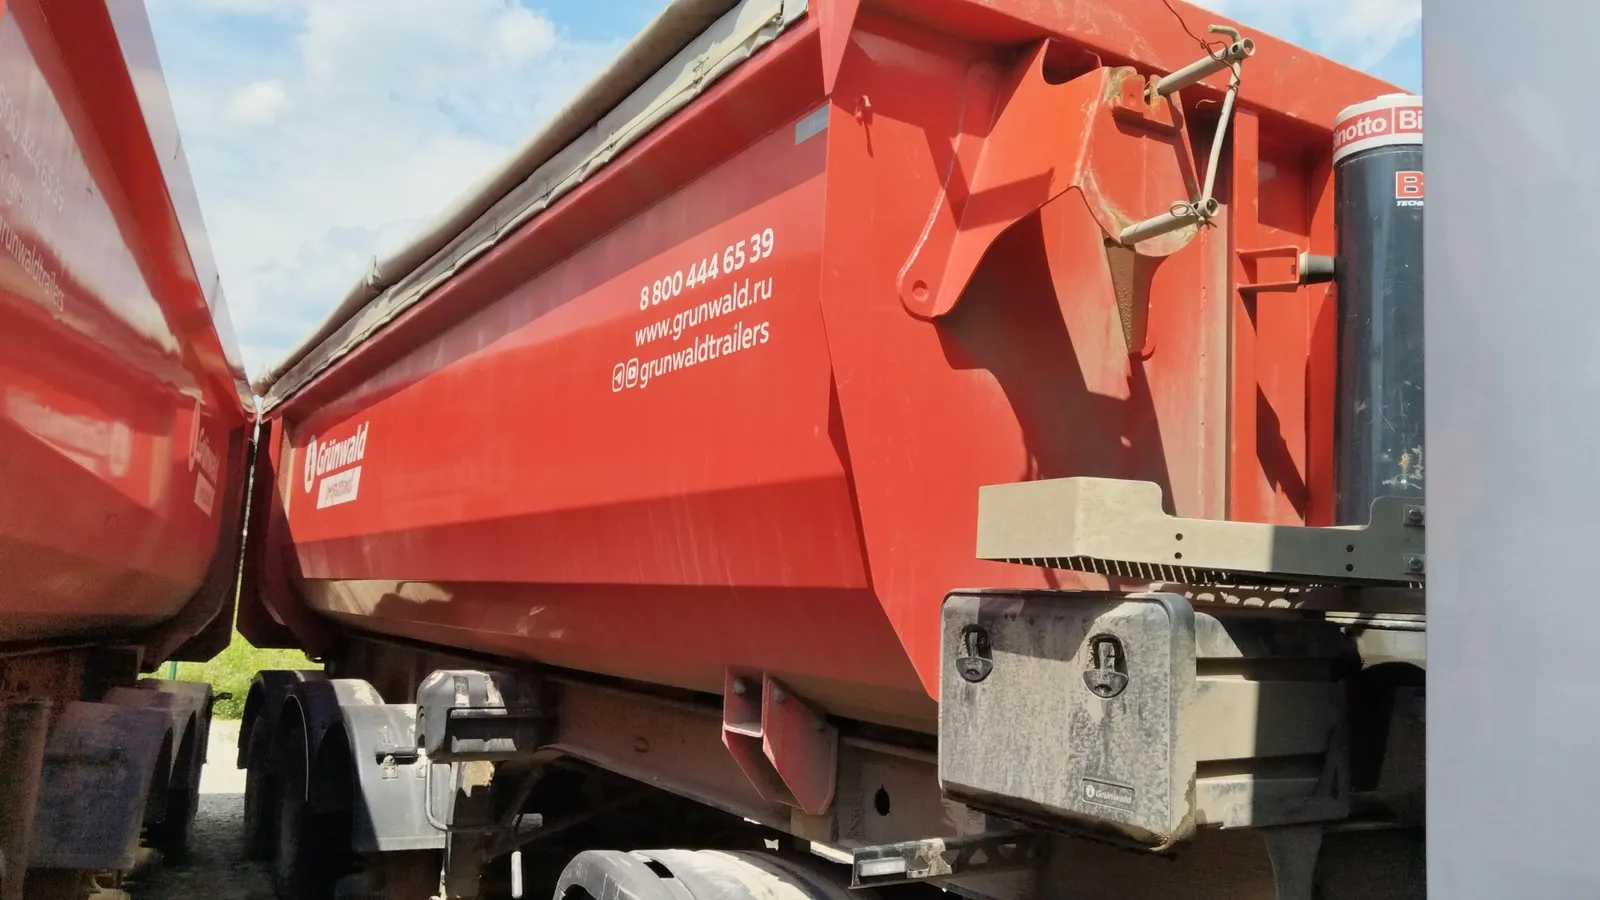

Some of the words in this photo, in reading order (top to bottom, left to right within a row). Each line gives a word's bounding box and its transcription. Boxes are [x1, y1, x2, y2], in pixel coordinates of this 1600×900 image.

[41, 158, 54, 195] 65
[0, 214, 65, 313] runwaldtrailers
[639, 285, 649, 311] 8
[652, 270, 683, 306] 800
[685, 252, 719, 289] 444
[722, 239, 746, 275] 65
[749, 227, 775, 264] 39
[635, 276, 773, 347] www.grunwald.ru
[639, 320, 770, 389] grunwaldtrailers
[316, 420, 370, 477] Grünwald
